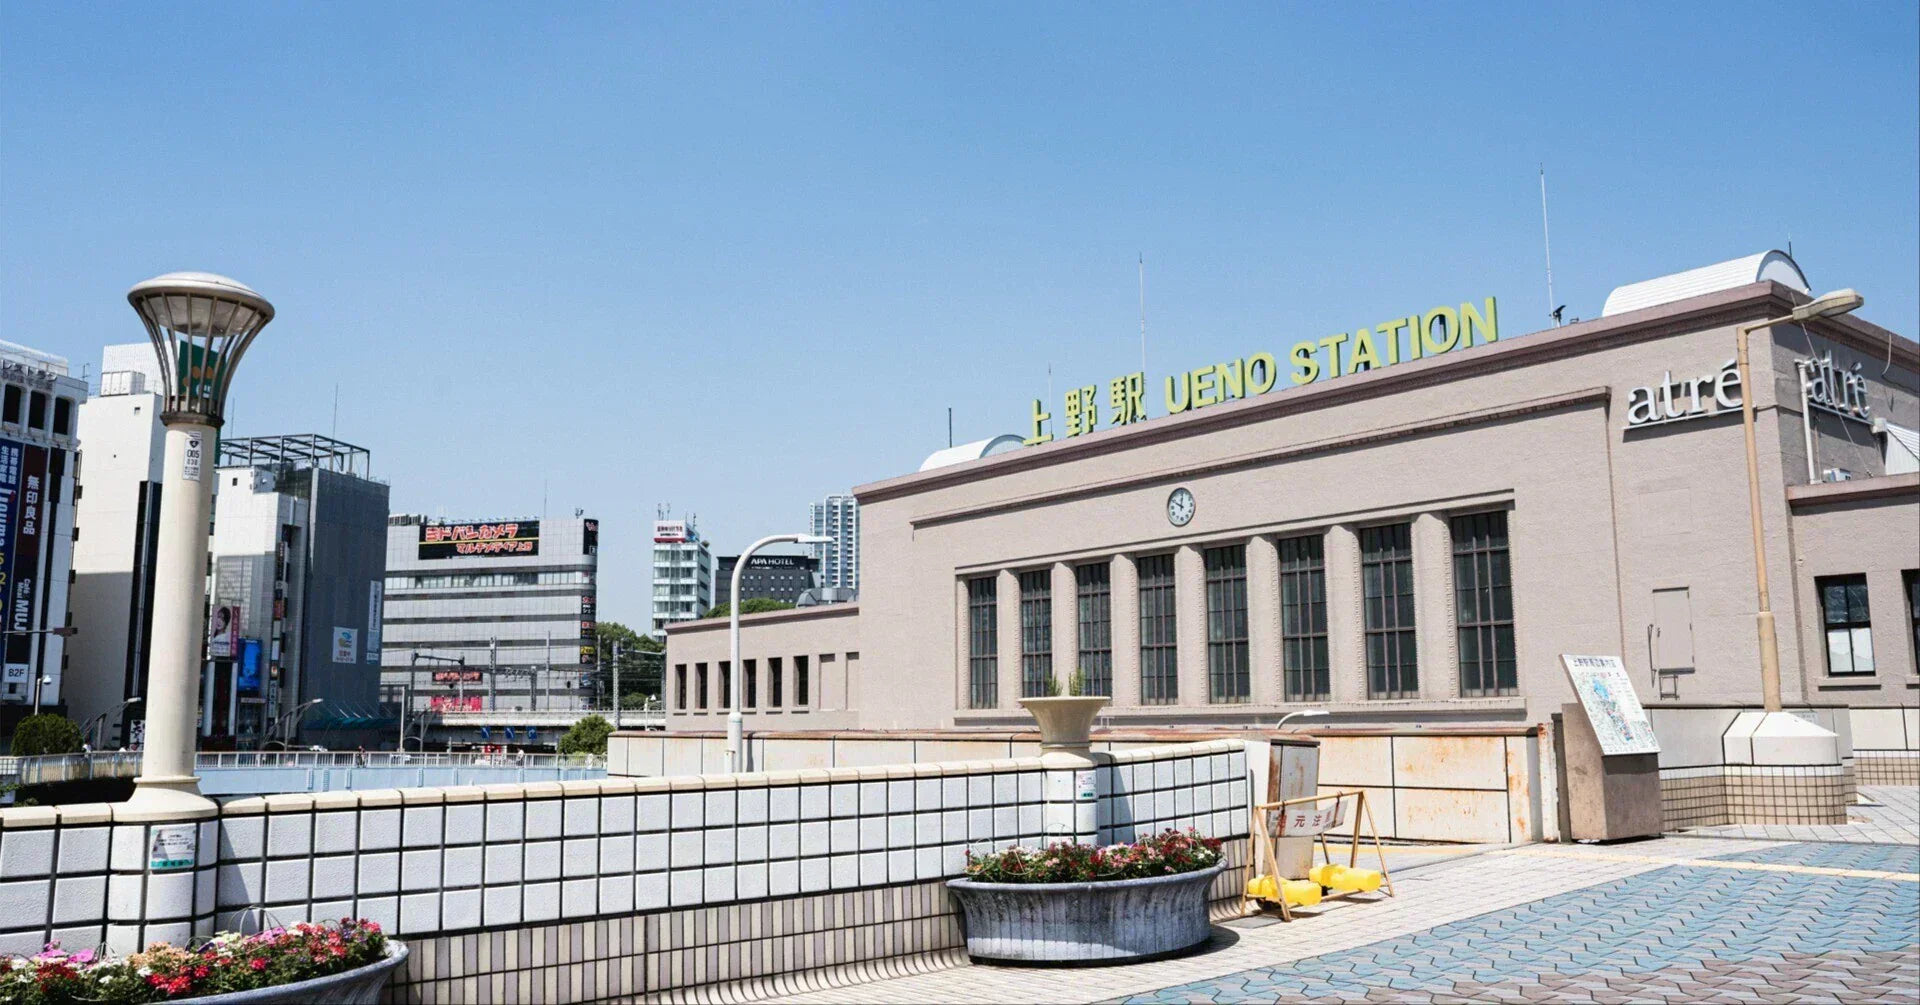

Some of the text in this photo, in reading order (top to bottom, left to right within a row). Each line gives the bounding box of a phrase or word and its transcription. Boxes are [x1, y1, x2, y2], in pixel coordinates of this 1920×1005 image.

[1023, 297, 1499, 446] 上野駅 UENO STATION
[1628, 359, 1743, 424] atré
[23, 474, 39, 535] 無印良品
[425, 523, 519, 542] ヨドバシカメラ
[751, 557, 767, 565] APA
